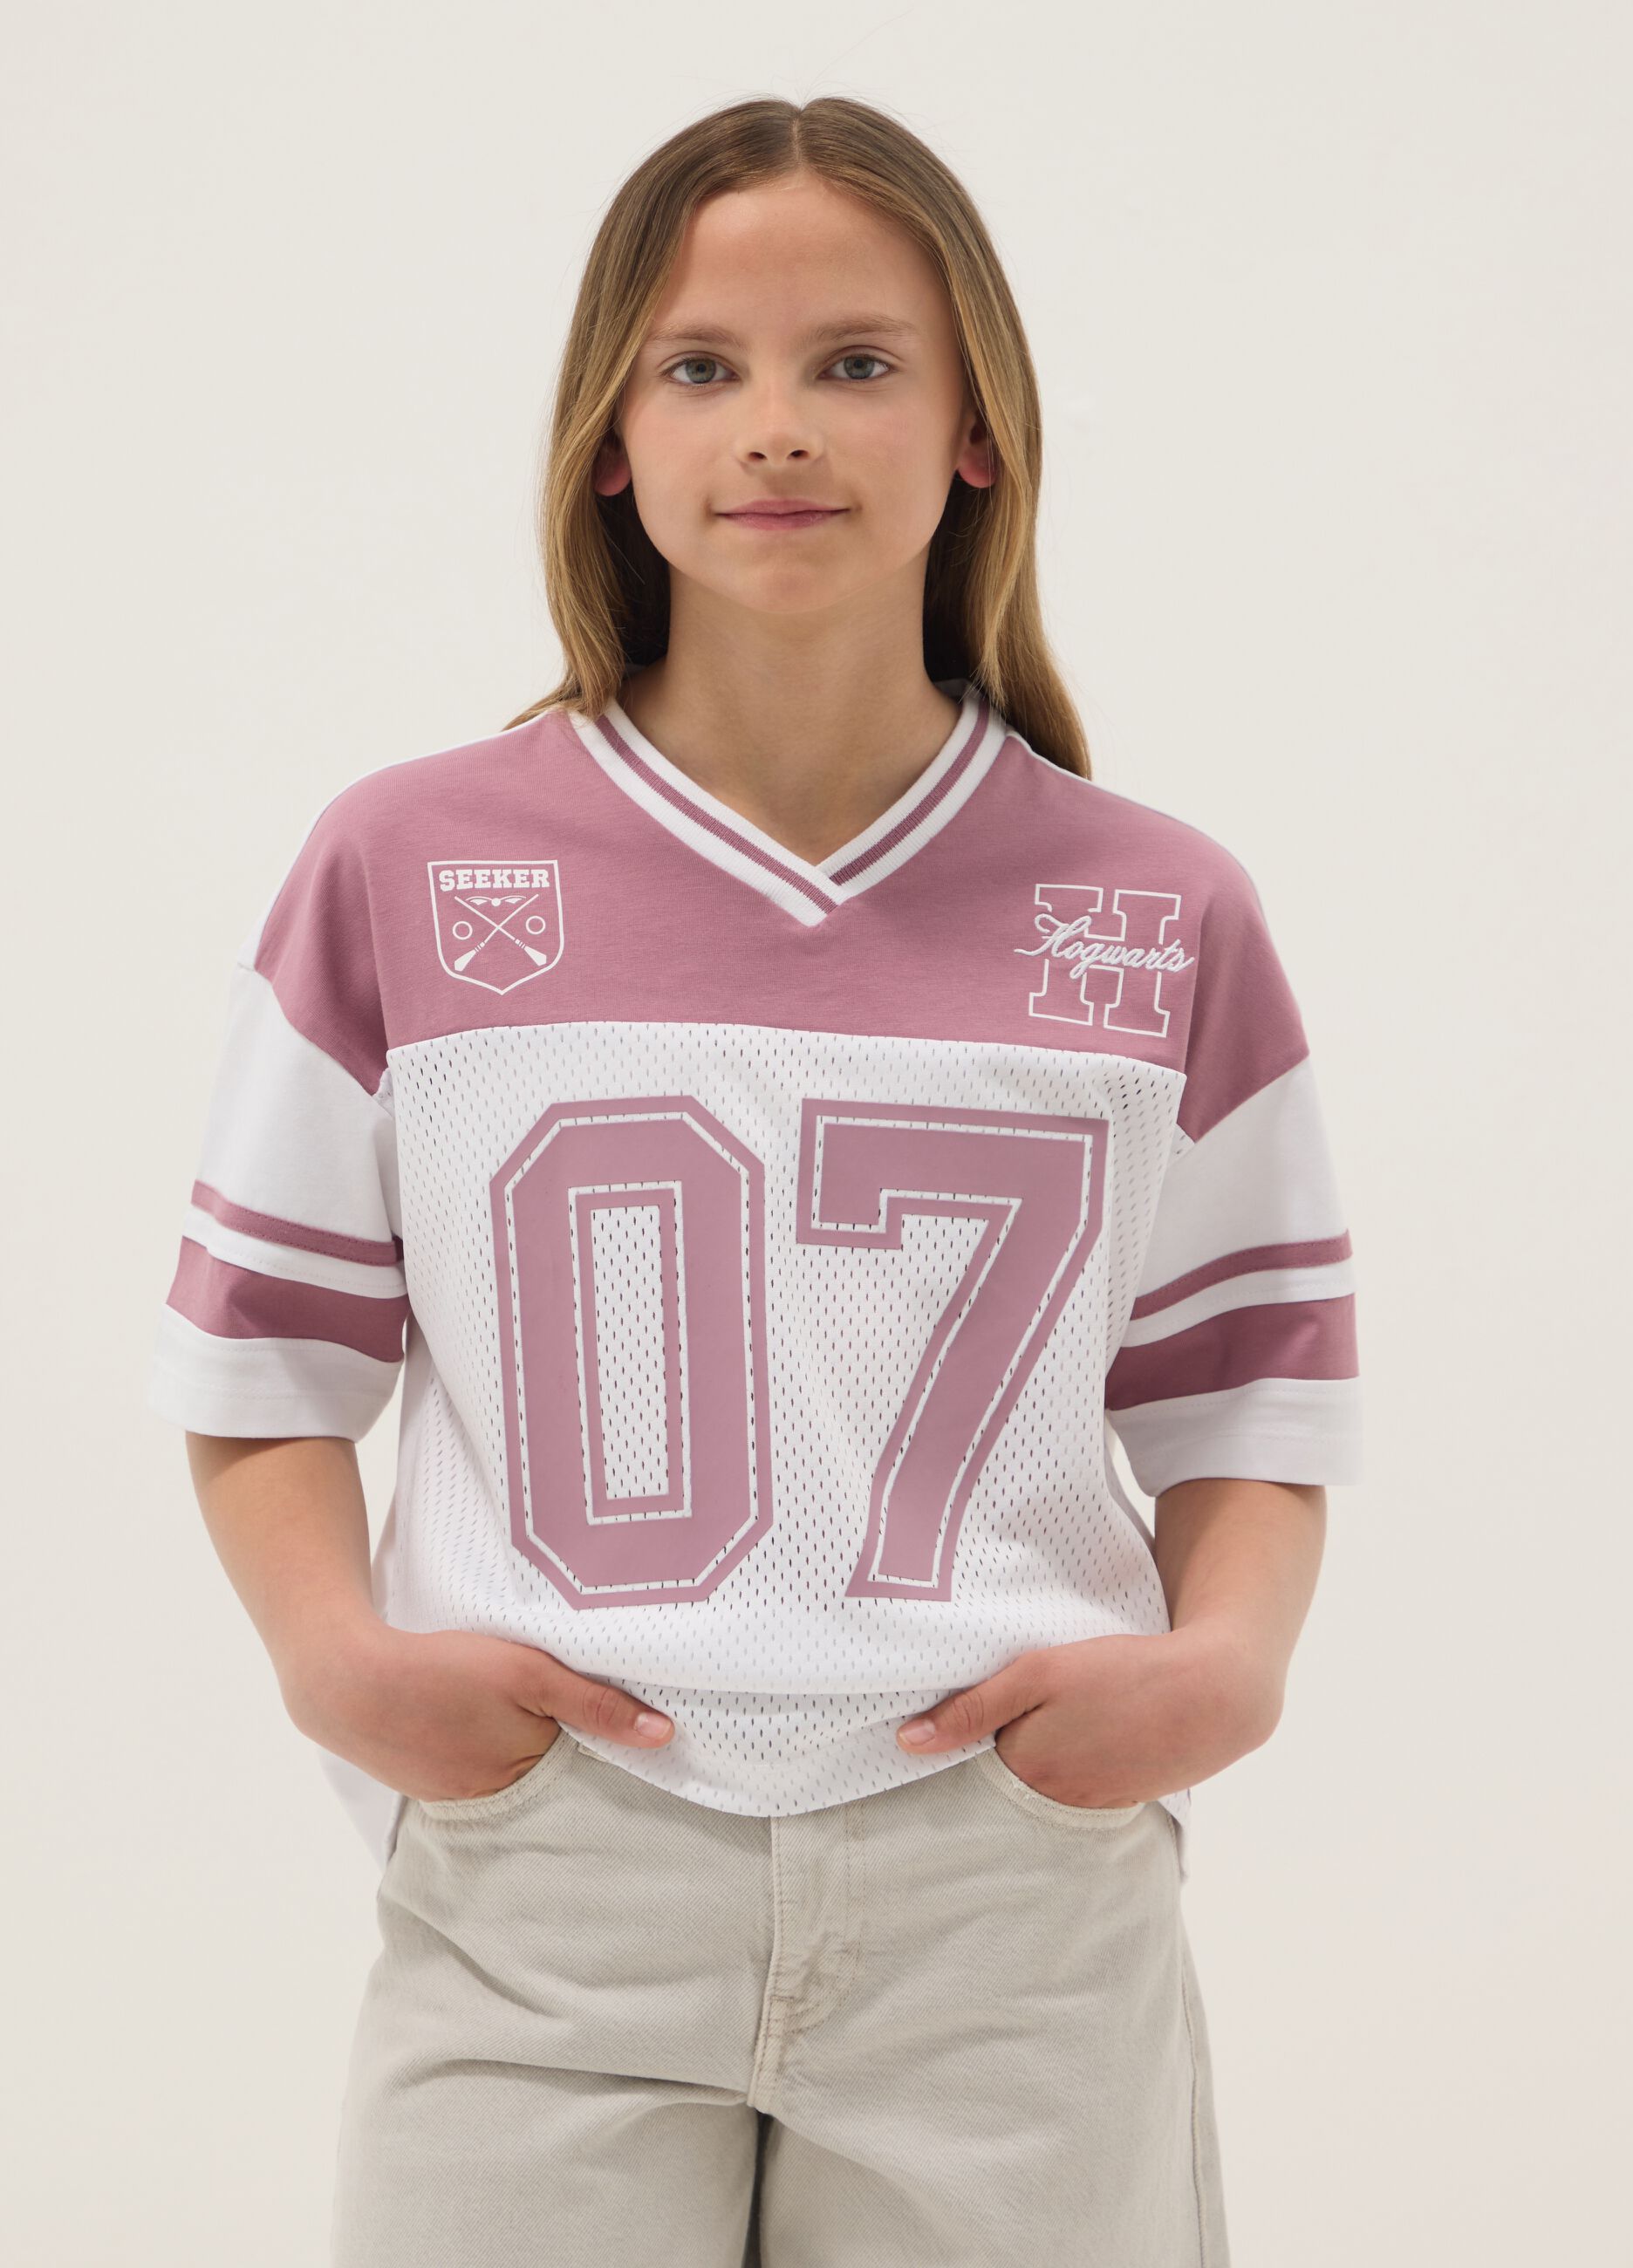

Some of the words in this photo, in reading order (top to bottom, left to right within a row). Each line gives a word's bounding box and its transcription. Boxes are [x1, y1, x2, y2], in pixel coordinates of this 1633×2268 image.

[438, 869, 550, 891] SEEKER
[1014, 913, 1195, 980] Hogwarts
[1028, 884, 1181, 1037] H
[489, 1095, 1109, 1610] 07
